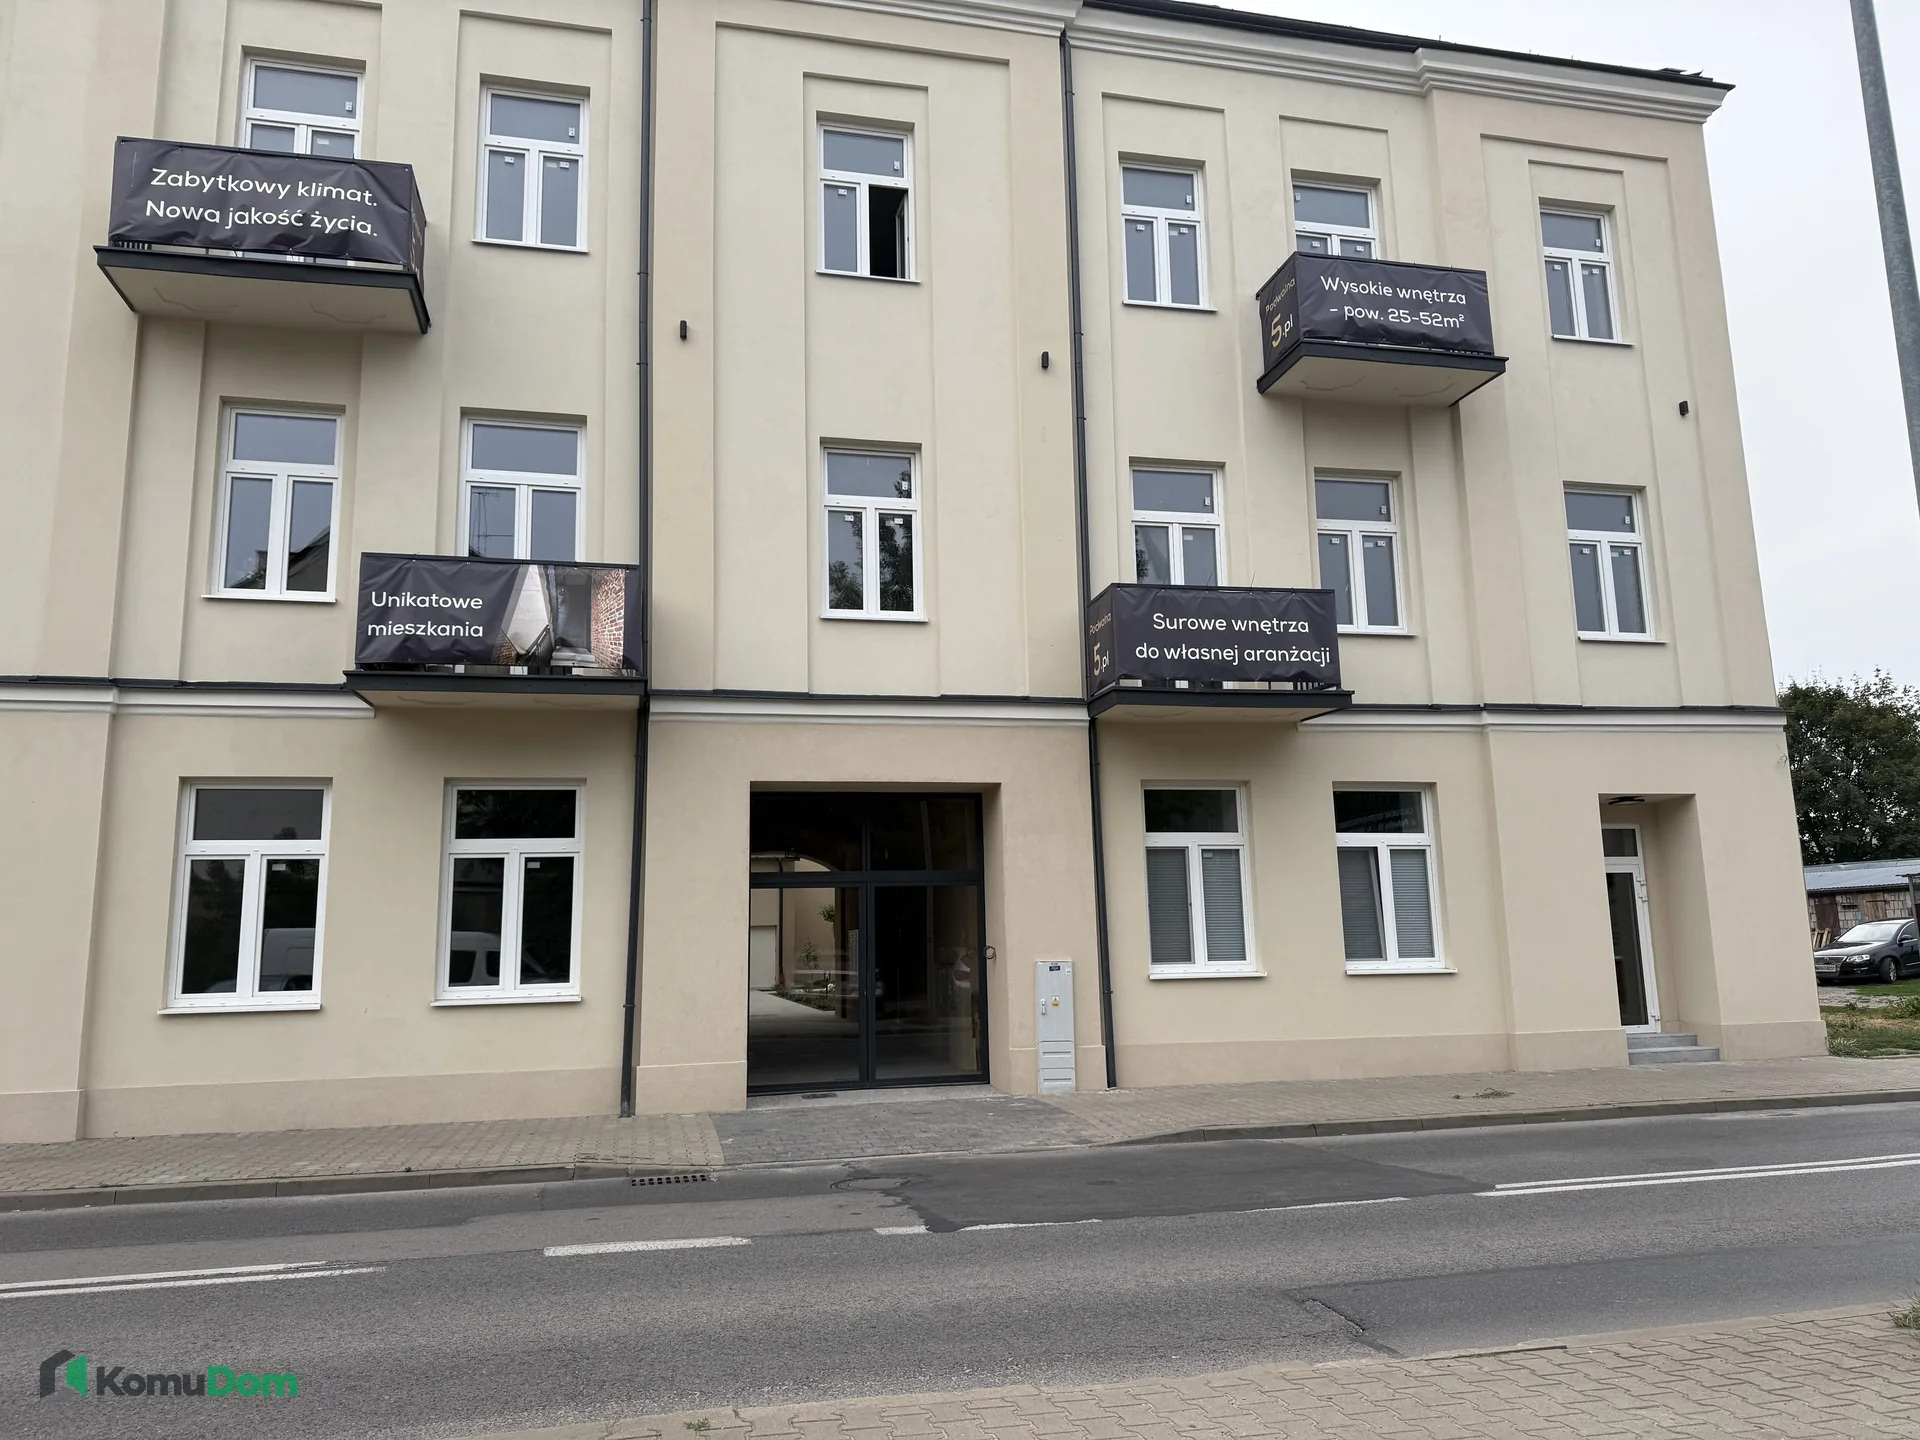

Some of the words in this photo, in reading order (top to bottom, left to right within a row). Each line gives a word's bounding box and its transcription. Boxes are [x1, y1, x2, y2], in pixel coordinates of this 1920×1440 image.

[150, 167, 292, 200] Zabytkowy
[297, 180, 378, 207] klimat.
[145, 199, 221, 224] Nowa
[224, 206, 304, 230] jakość
[309, 210, 378, 237] życia.
[1320, 275, 1393, 297] Wysokie
[1396, 287, 1467, 305] wnętrza
[1343, 305, 1384, 321] pow.
[371, 591, 483, 610] Unikatowe
[367, 620, 484, 638] mieszkania
[1152, 612, 1227, 631] Surowe
[1231, 617, 1309, 635] wnętrza
[1135, 642, 1160, 659] do
[1163, 643, 1239, 666] własnej
[1243, 645, 1330, 668] aranżacji
